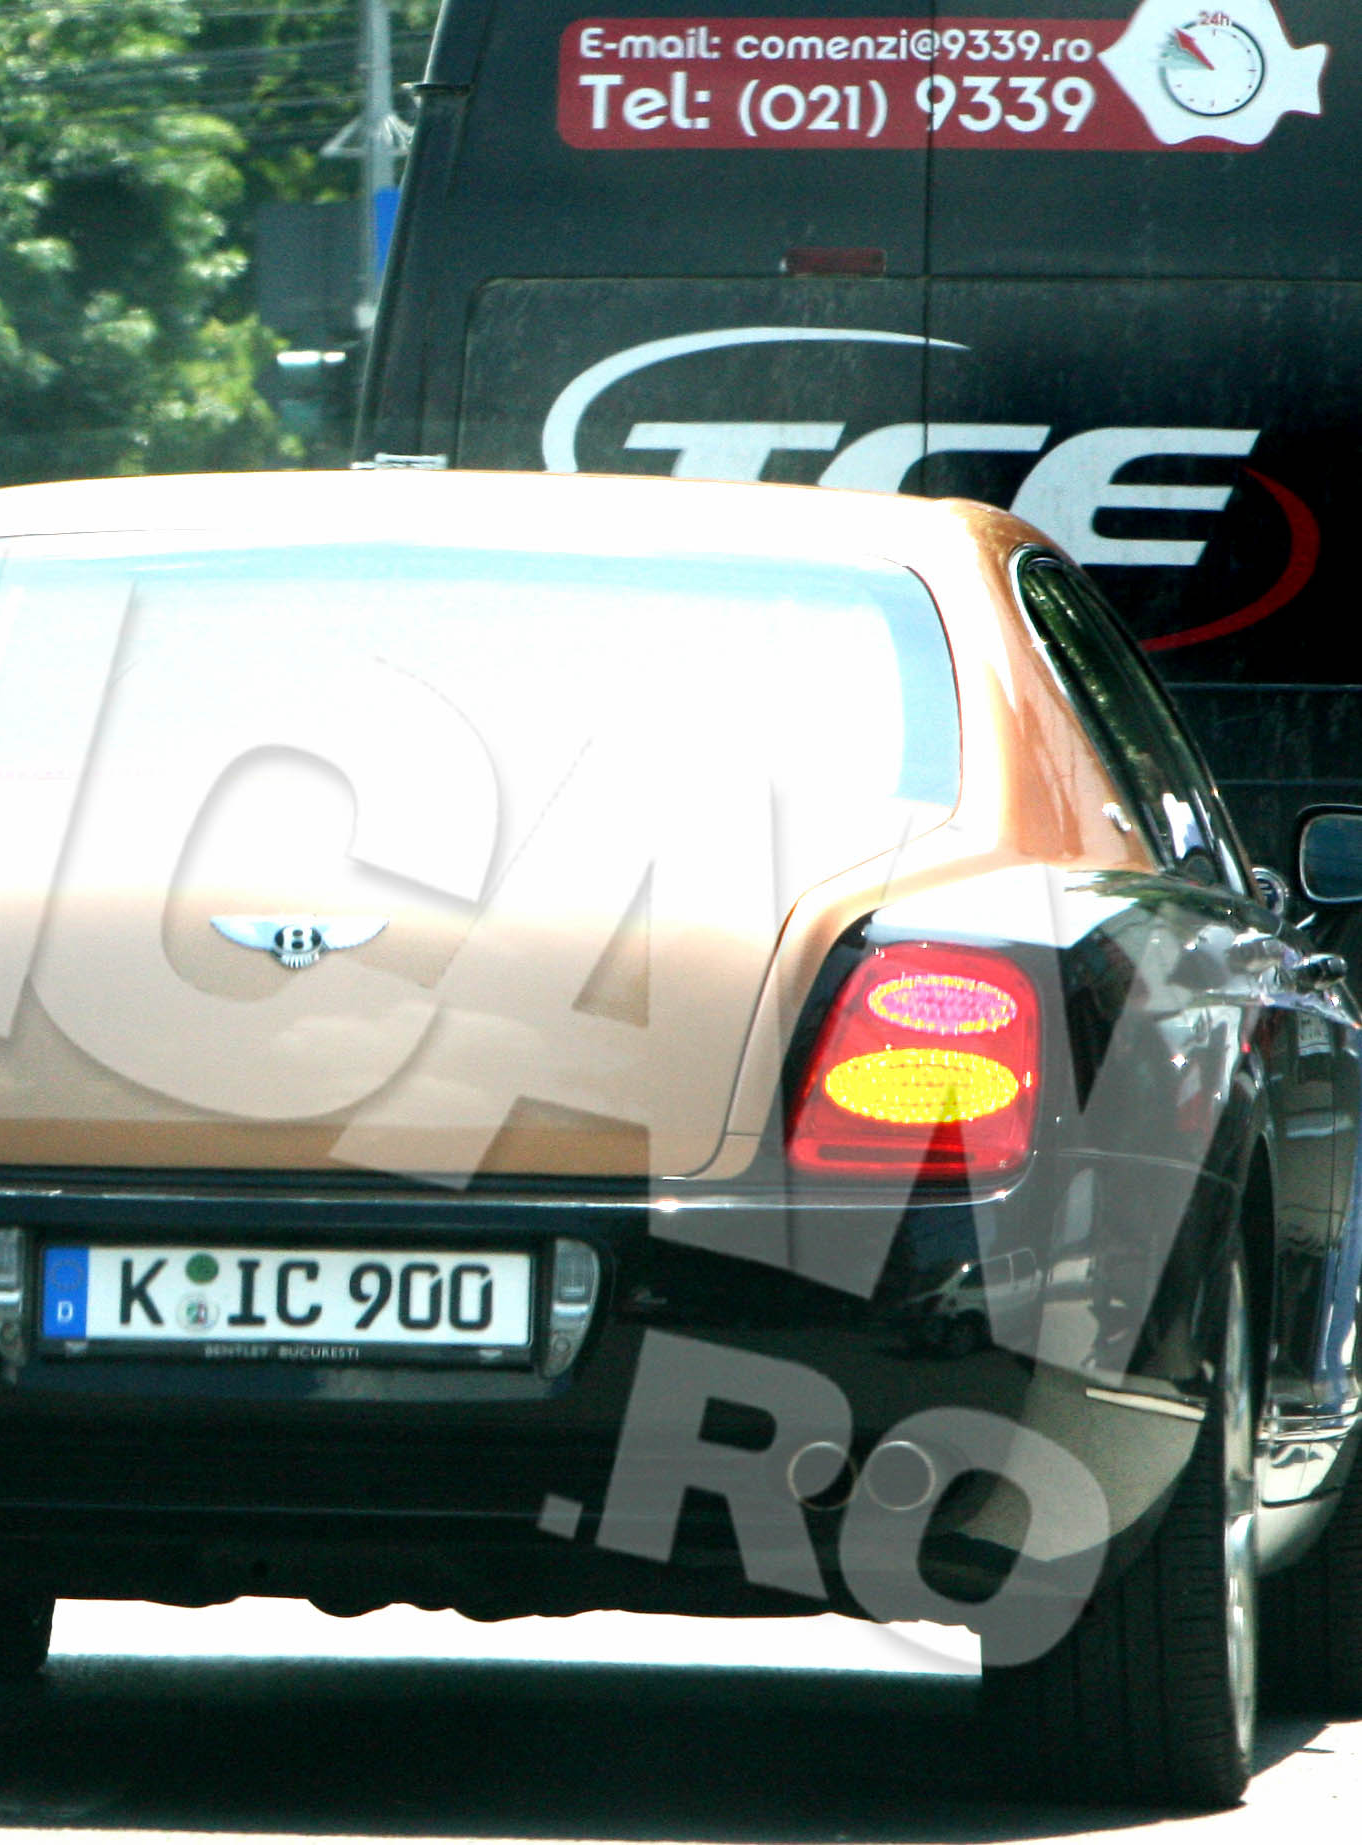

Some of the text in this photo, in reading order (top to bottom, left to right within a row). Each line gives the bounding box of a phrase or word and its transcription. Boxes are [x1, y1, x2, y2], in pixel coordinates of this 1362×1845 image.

[579, 26, 1093, 63] E-mail: comenzi@9339.ro
[579, 71, 1096, 138] Tel: (021) 9339
[56, 1303, 73, 1323] D
[119, 1258, 494, 1332] K IC 900
